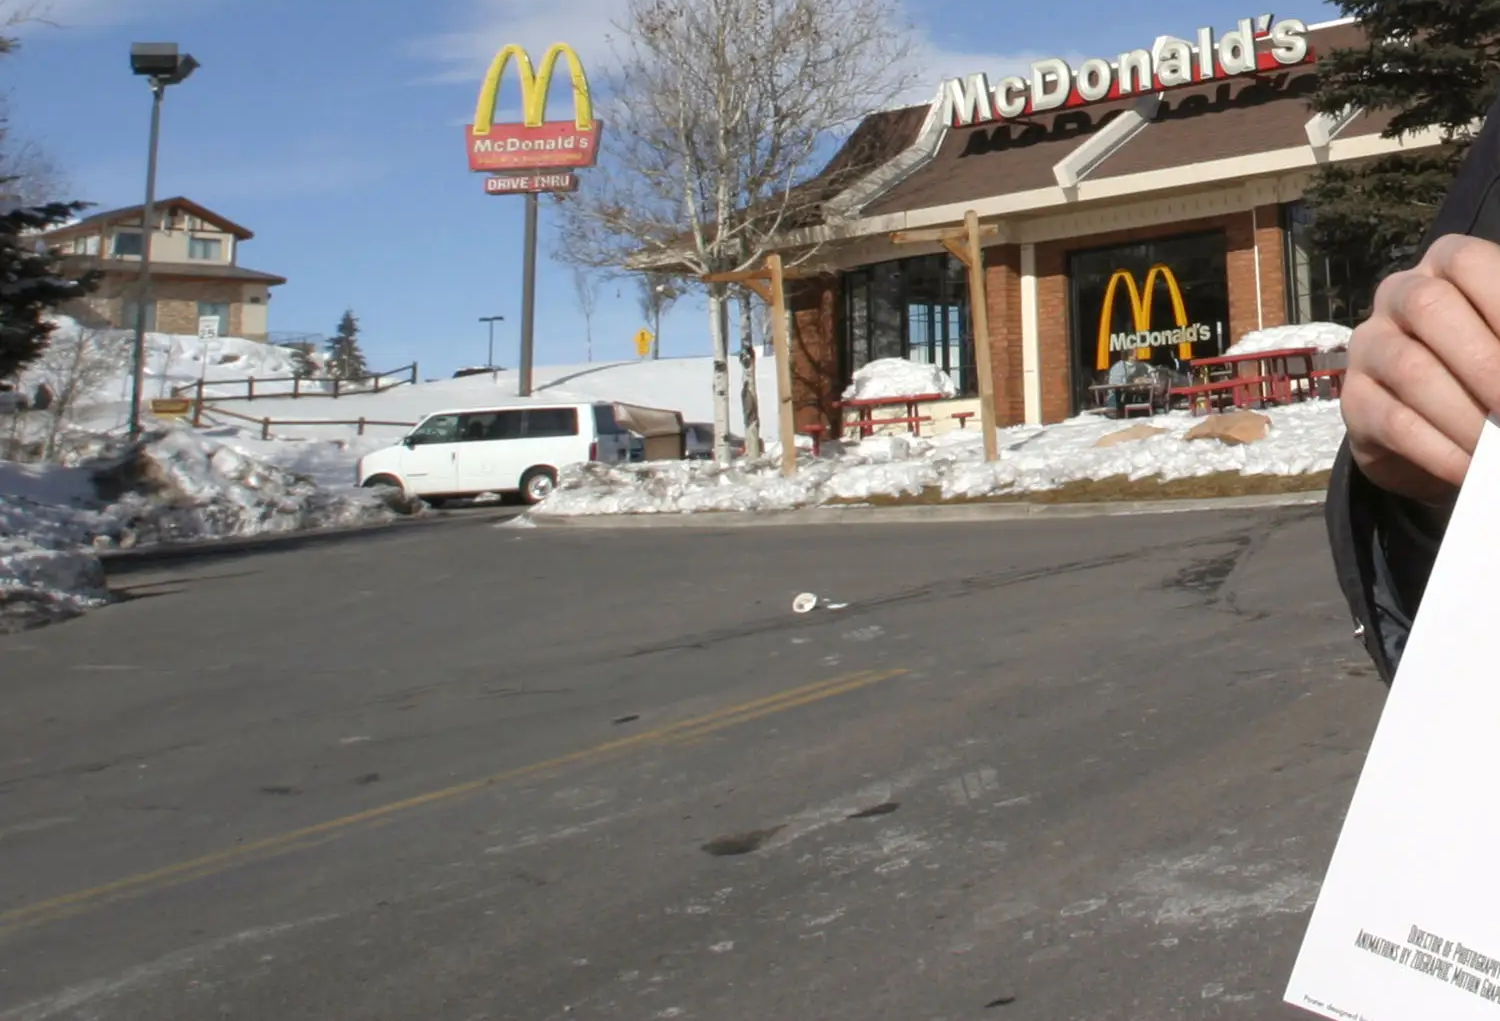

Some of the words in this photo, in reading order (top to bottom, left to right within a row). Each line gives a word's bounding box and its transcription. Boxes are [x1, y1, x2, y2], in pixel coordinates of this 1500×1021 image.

[944, 13, 1308, 128] McDonald's
[473, 135, 589, 153] McDonald's
[486, 176, 529, 191] DRIVE
[533, 174, 570, 189] THRU
[1109, 322, 1211, 352] McDonald's
